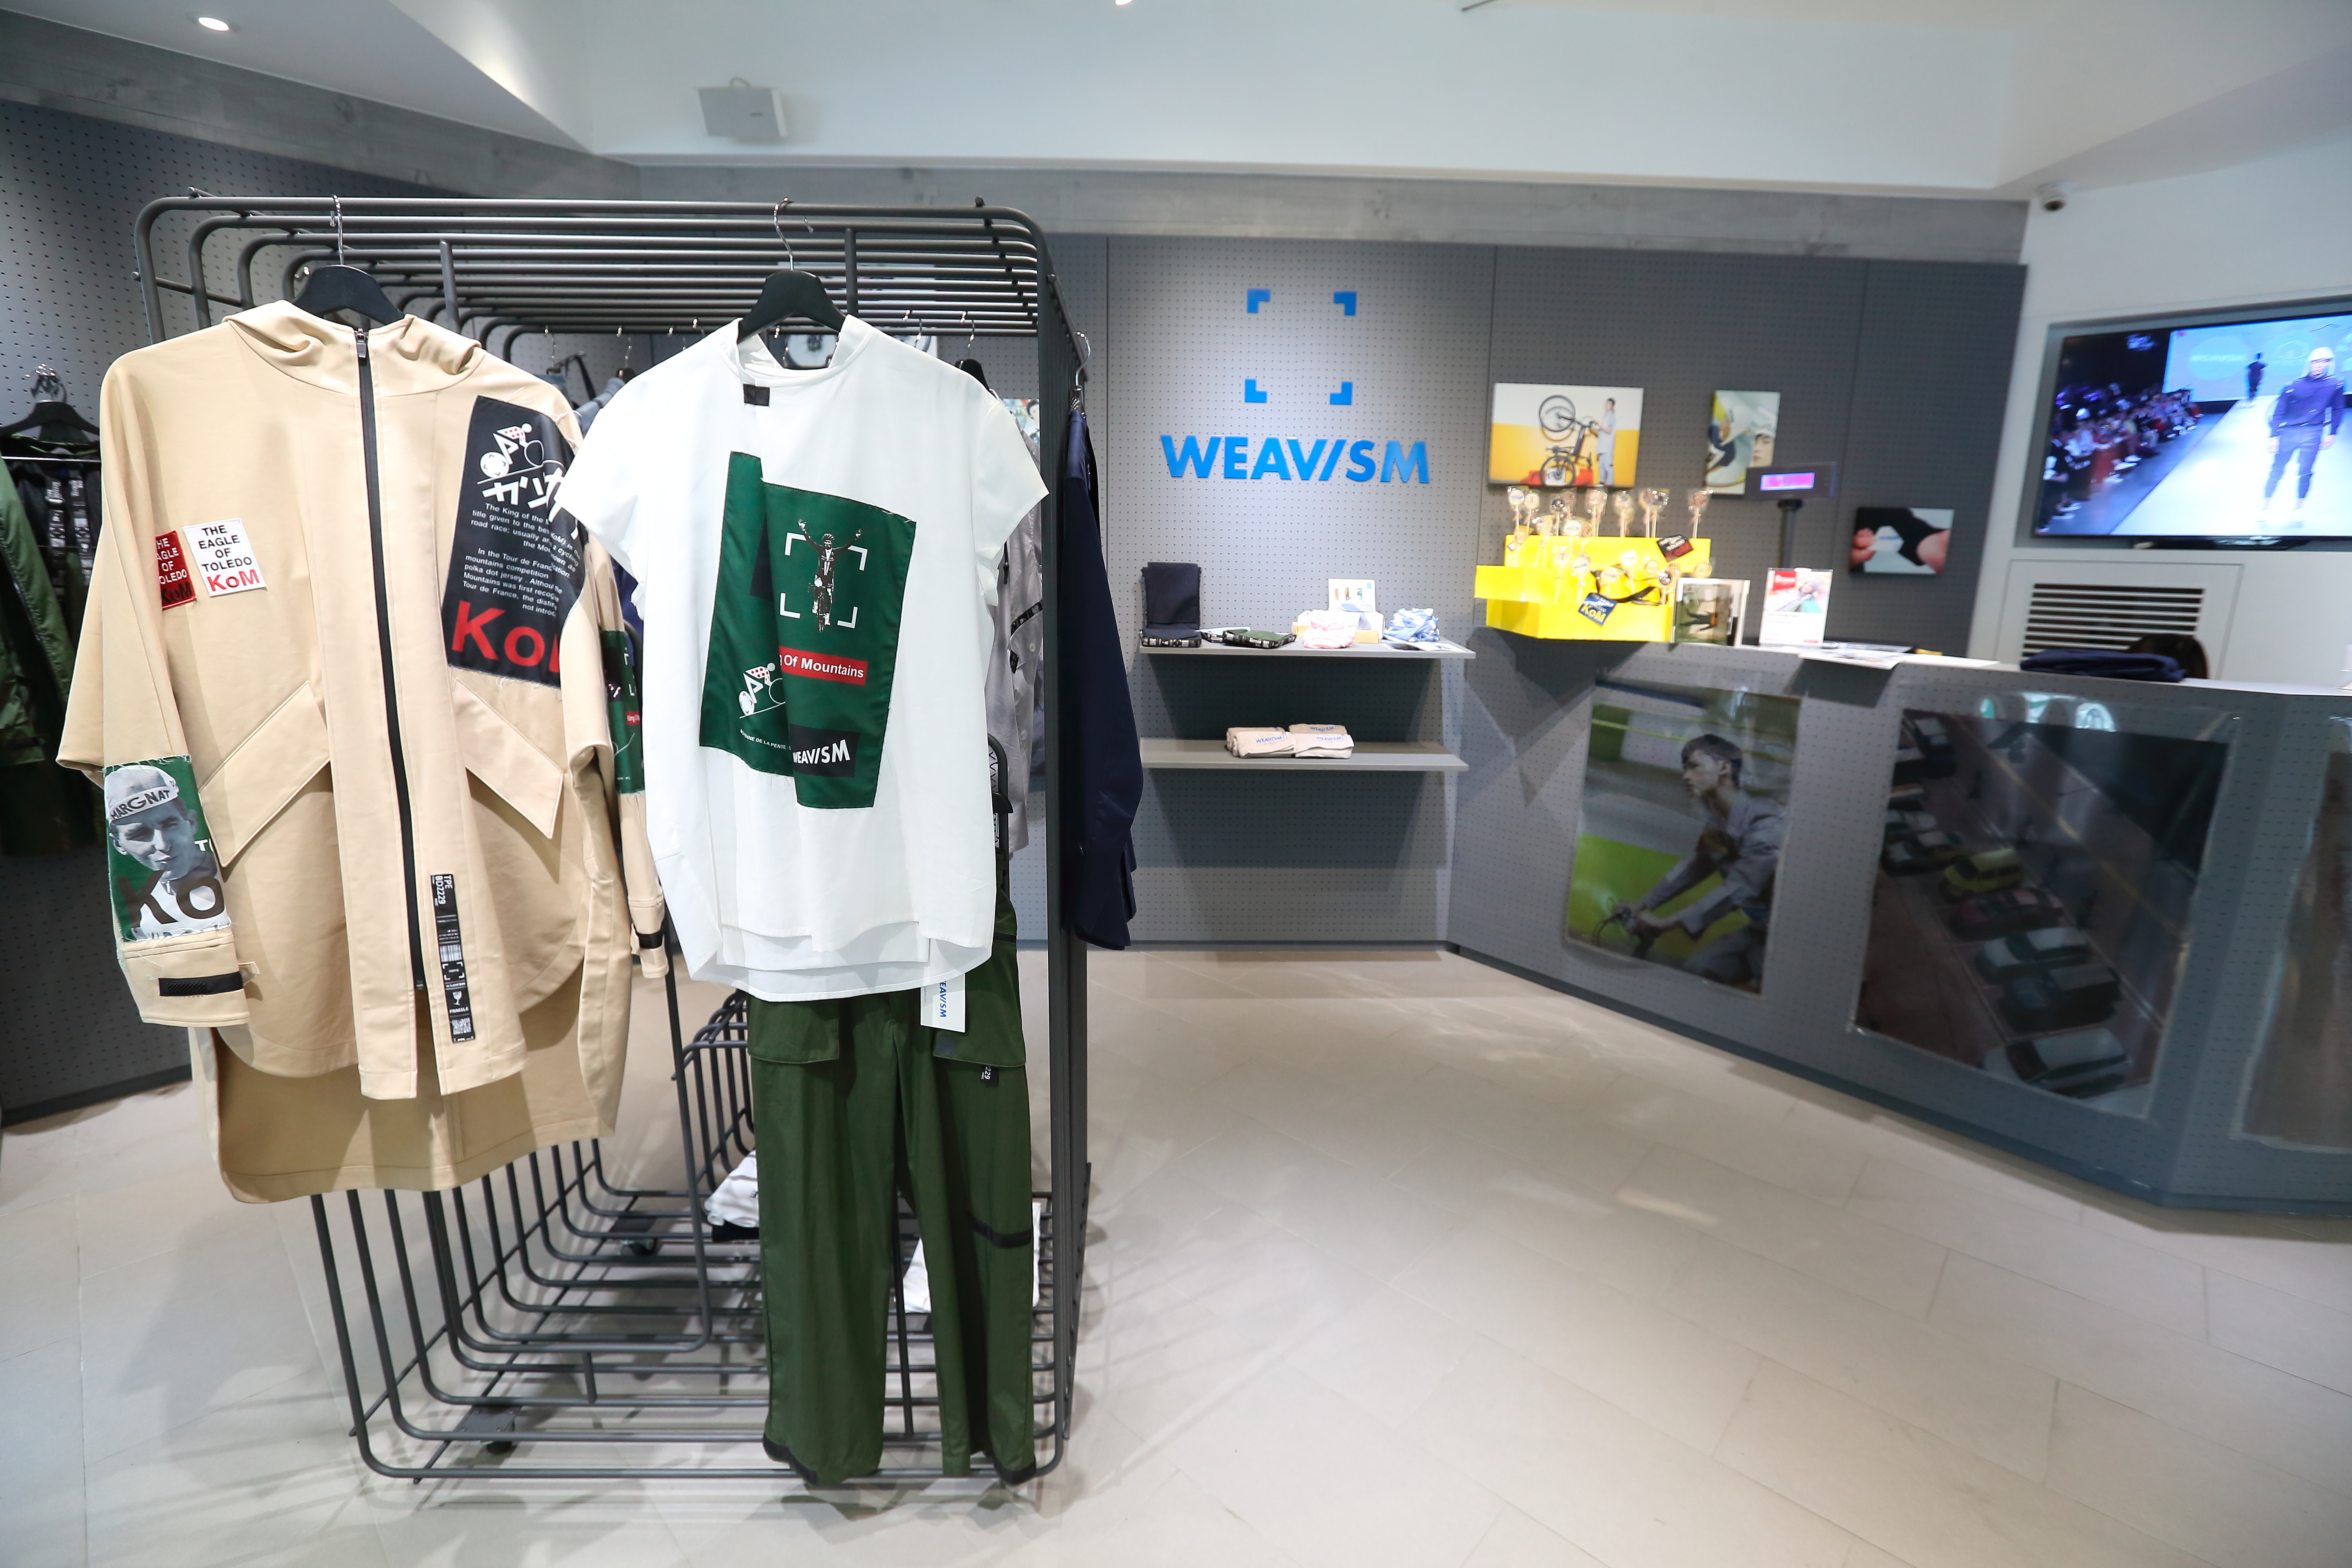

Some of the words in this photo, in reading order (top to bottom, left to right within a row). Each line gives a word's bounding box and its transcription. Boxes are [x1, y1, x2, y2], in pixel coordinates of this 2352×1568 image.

[1160, 434, 1429, 483] WEAVISM
[472, 510, 486, 518] title
[490, 514, 510, 524] given
[523, 522, 535, 530] the
[485, 503, 500, 512] The
[502, 507, 519, 518] King
[532, 515, 543, 523] the
[202, 525, 227, 536] THE
[156, 538, 170, 550] HE
[198, 535, 240, 549] EAGLE
[471, 519, 488, 528] road
[513, 529, 540, 541] usually
[550, 553, 566, 566] nown
[568, 564, 575, 572] as
[523, 540, 535, 548] the
[157, 547, 179, 561] AGLE
[215, 548, 231, 558] OF
[488, 550, 500, 559] the
[502, 553, 518, 562] Tour
[520, 558, 530, 566] de
[532, 560, 552, 572] Franc
[161, 561, 174, 571] OF
[202, 557, 252, 572] TOLEDO
[466, 555, 504, 569] mountains
[506, 563, 549, 579] competition
[159, 569, 187, 584] OLEDO
[207, 570, 260, 591] KoM
[463, 572, 501, 586] Mountains
[519, 584, 532, 593] first
[465, 564, 483, 573] polka
[486, 568, 498, 577] dot
[500, 572, 523, 583] jersey
[529, 578, 555, 589] Althou
[463, 581, 477, 590] Tour
[479, 585, 490, 593] de
[784, 655, 798, 667] Of
[801, 657, 864, 678] Mountains
[793, 739, 851, 764] WEAVISM
[111, 790, 169, 819] MARGNAT
[435, 875, 446, 905] BD2229
[443, 875, 453, 889] TPE
